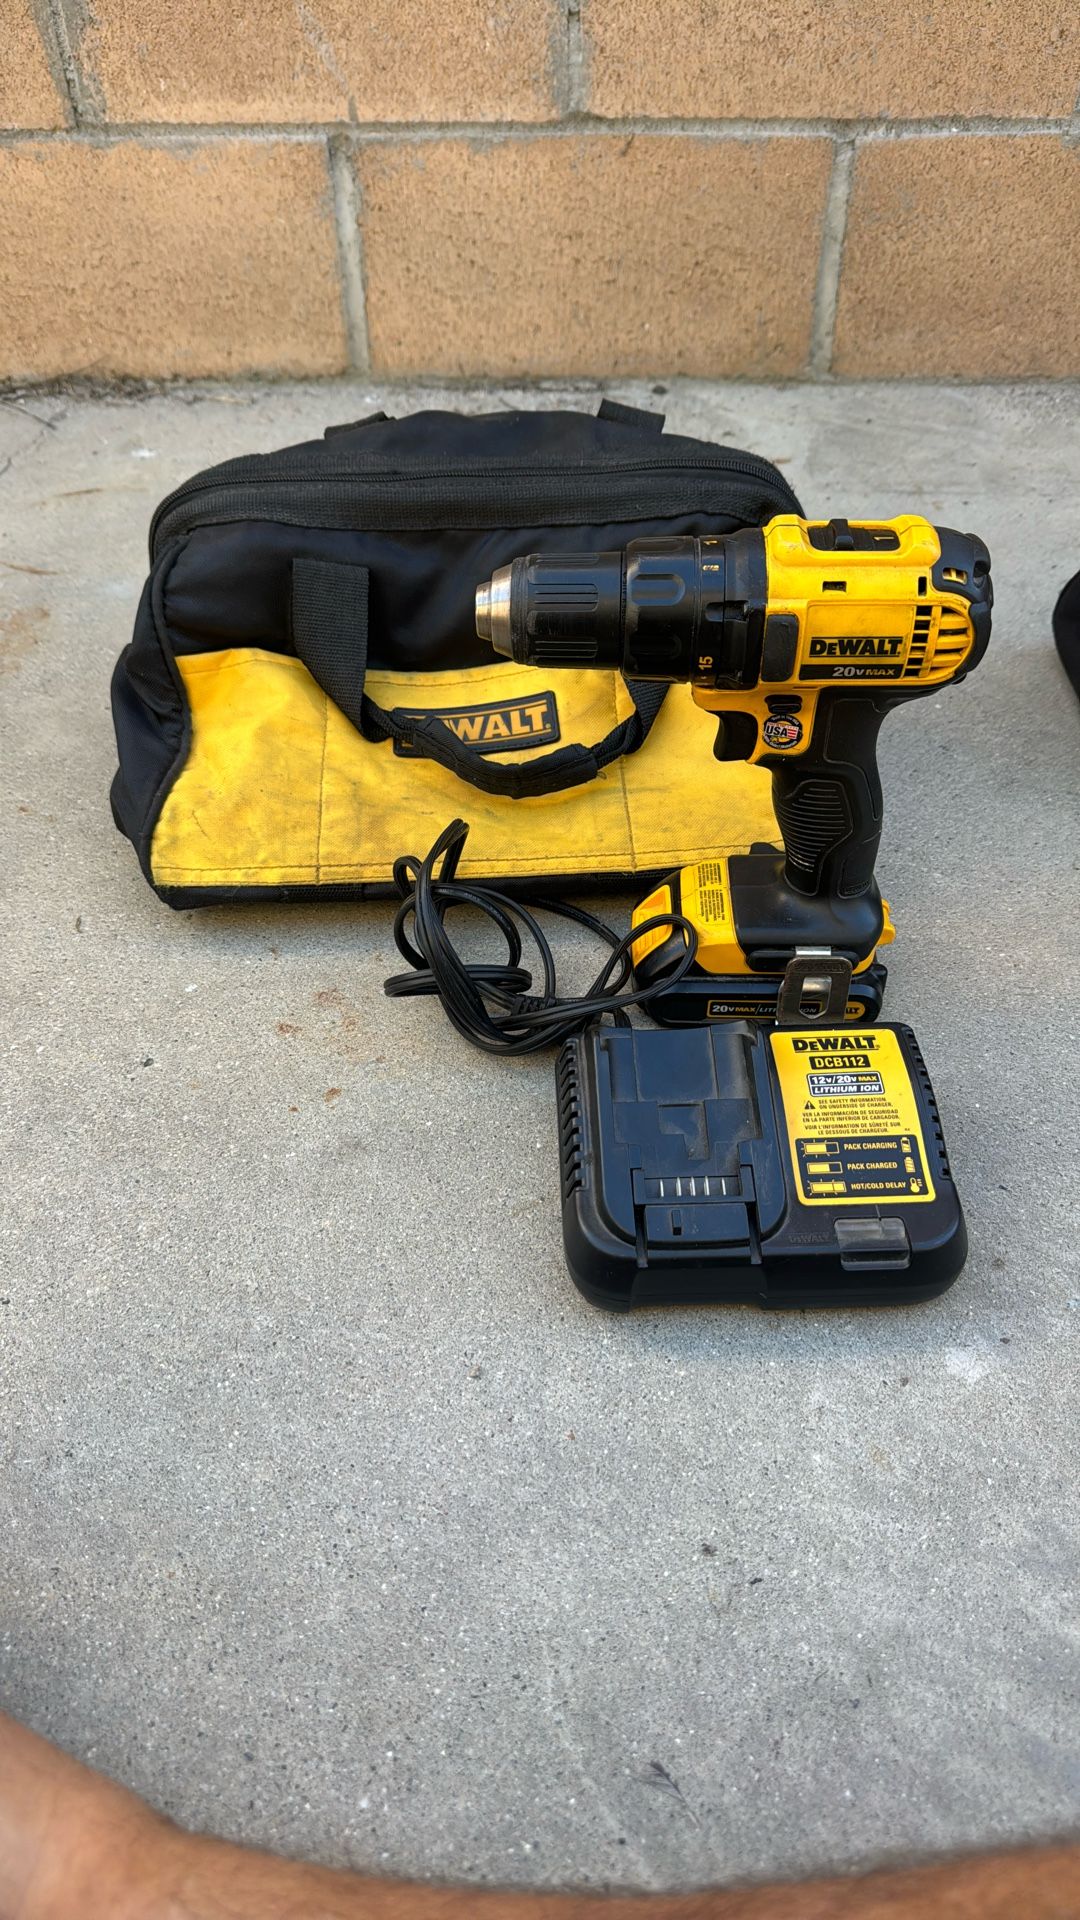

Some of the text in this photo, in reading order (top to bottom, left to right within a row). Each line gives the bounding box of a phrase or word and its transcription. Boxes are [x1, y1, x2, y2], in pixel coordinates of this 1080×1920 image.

[809, 639, 903, 655] DEWALT
[698, 656, 713, 670] 15
[832, 666, 865, 677] 20V
[444, 704, 548, 741] WALT
[766, 725, 788, 737] USA
[712, 1004, 735, 1013] 20V
[792, 1036, 876, 1051] DEWALT
[814, 1056, 866, 1068] DCB112
[814, 1084, 880, 1094] LITHIUM ION
[851, 1182, 884, 1190] HOT/COLD
